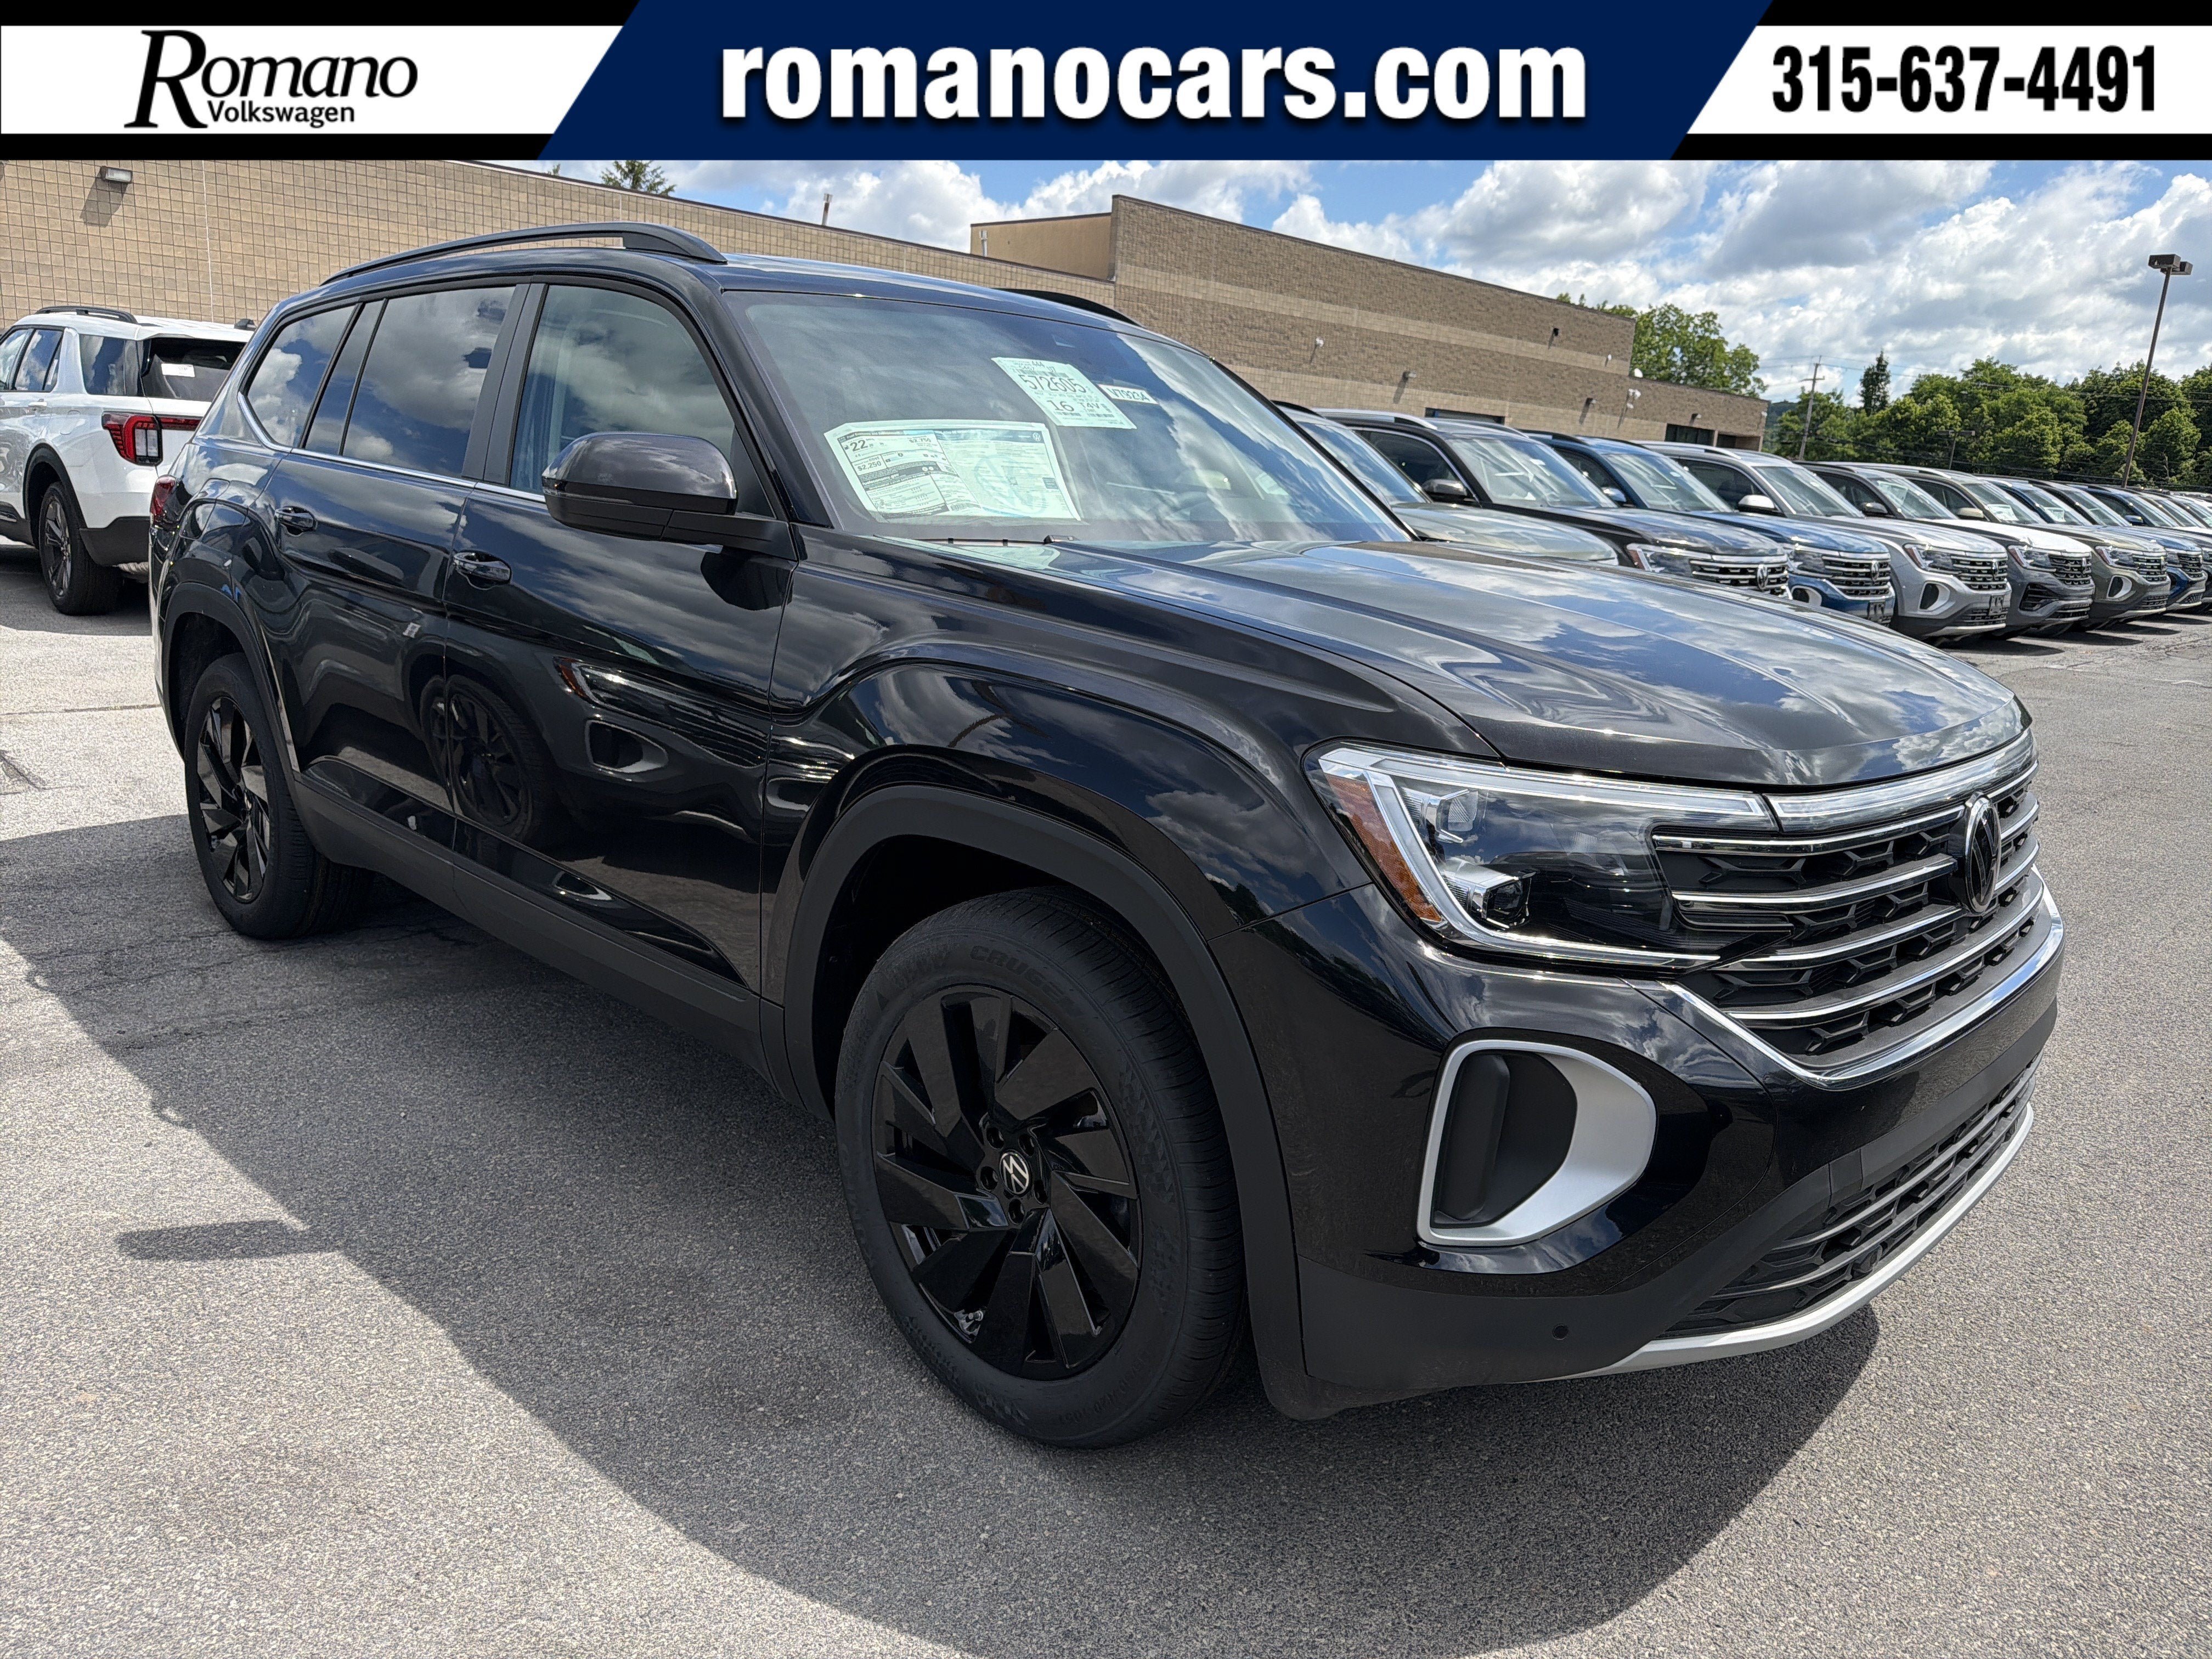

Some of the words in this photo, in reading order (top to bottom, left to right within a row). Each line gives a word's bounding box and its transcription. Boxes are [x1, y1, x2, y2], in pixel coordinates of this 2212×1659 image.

[1018, 374, 1087, 393] 572605
[1047, 400, 1075, 412] 16
[850, 439, 868, 452] 22
[857, 460, 882, 471] $2,250
